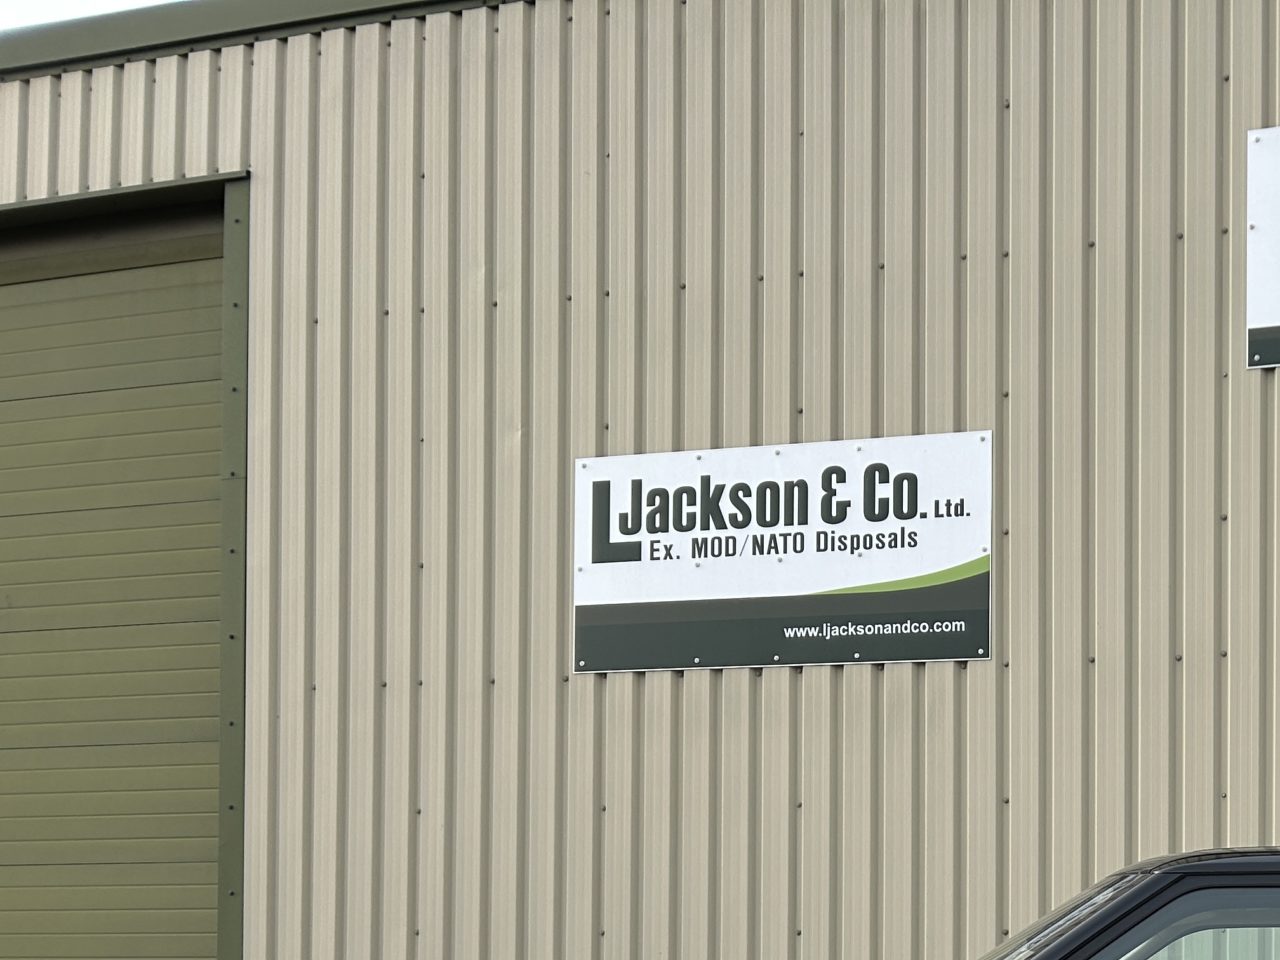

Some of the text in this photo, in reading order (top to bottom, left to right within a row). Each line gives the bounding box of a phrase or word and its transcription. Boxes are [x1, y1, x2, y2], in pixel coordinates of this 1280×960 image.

[820, 465, 852, 525] &
[863, 462, 928, 523] Co.
[934, 498, 971, 518] Ltd.
[649, 526, 919, 561] Ex. MOD/NATO Disposals
[783, 620, 966, 640] www.ljacksonandco.com
